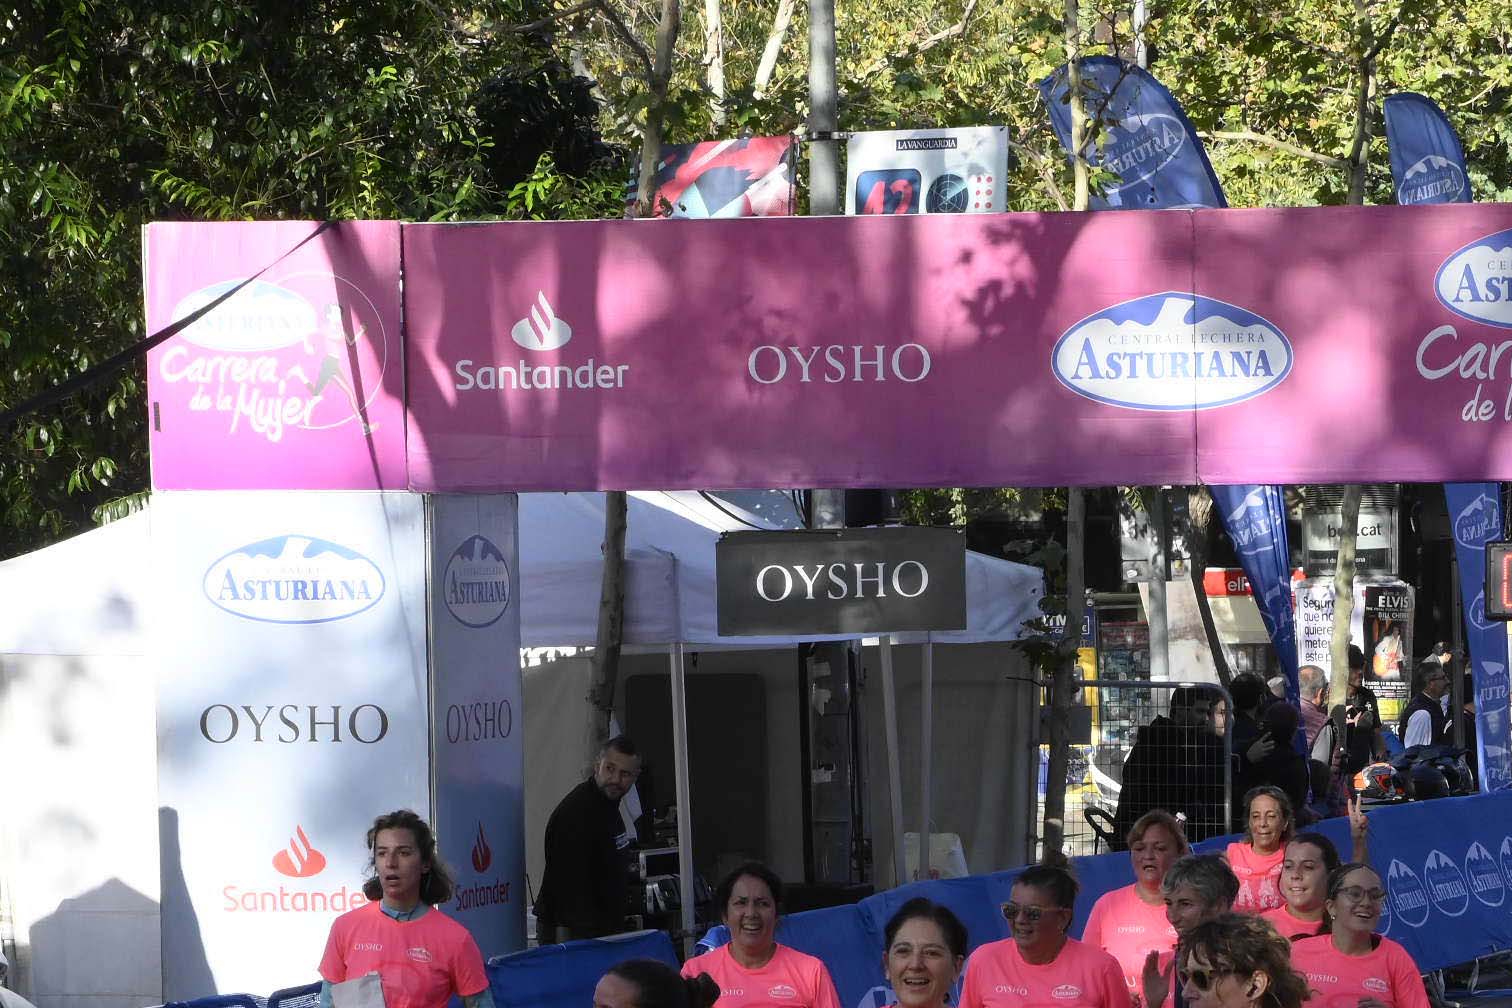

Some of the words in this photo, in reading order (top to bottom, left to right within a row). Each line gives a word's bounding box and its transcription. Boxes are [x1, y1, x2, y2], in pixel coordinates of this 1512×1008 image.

[1108, 334, 1184, 345] CENTRAL
[1190, 332, 1266, 344] LECHERA
[160, 346, 279, 383] Carrera
[456, 359, 629, 391] Santander
[748, 344, 931, 384] OYSHO
[1071, 336, 1274, 380] ASTURIANA
[231, 380, 323, 442] Mujer
[1462, 384, 1496, 422] de
[1328, 524, 1382, 538] b.cat
[218, 569, 372, 602] ASTURIANA
[449, 570, 507, 606] ASTURIANA
[756, 560, 929, 602] OYSHO
[1379, 596, 1408, 608] ELVIS
[200, 704, 389, 744] OYSHO
[447, 699, 512, 744] OYSHO
[223, 884, 366, 913] Santande
[456, 880, 511, 913] Santander
[354, 943, 383, 951] OYSHO
